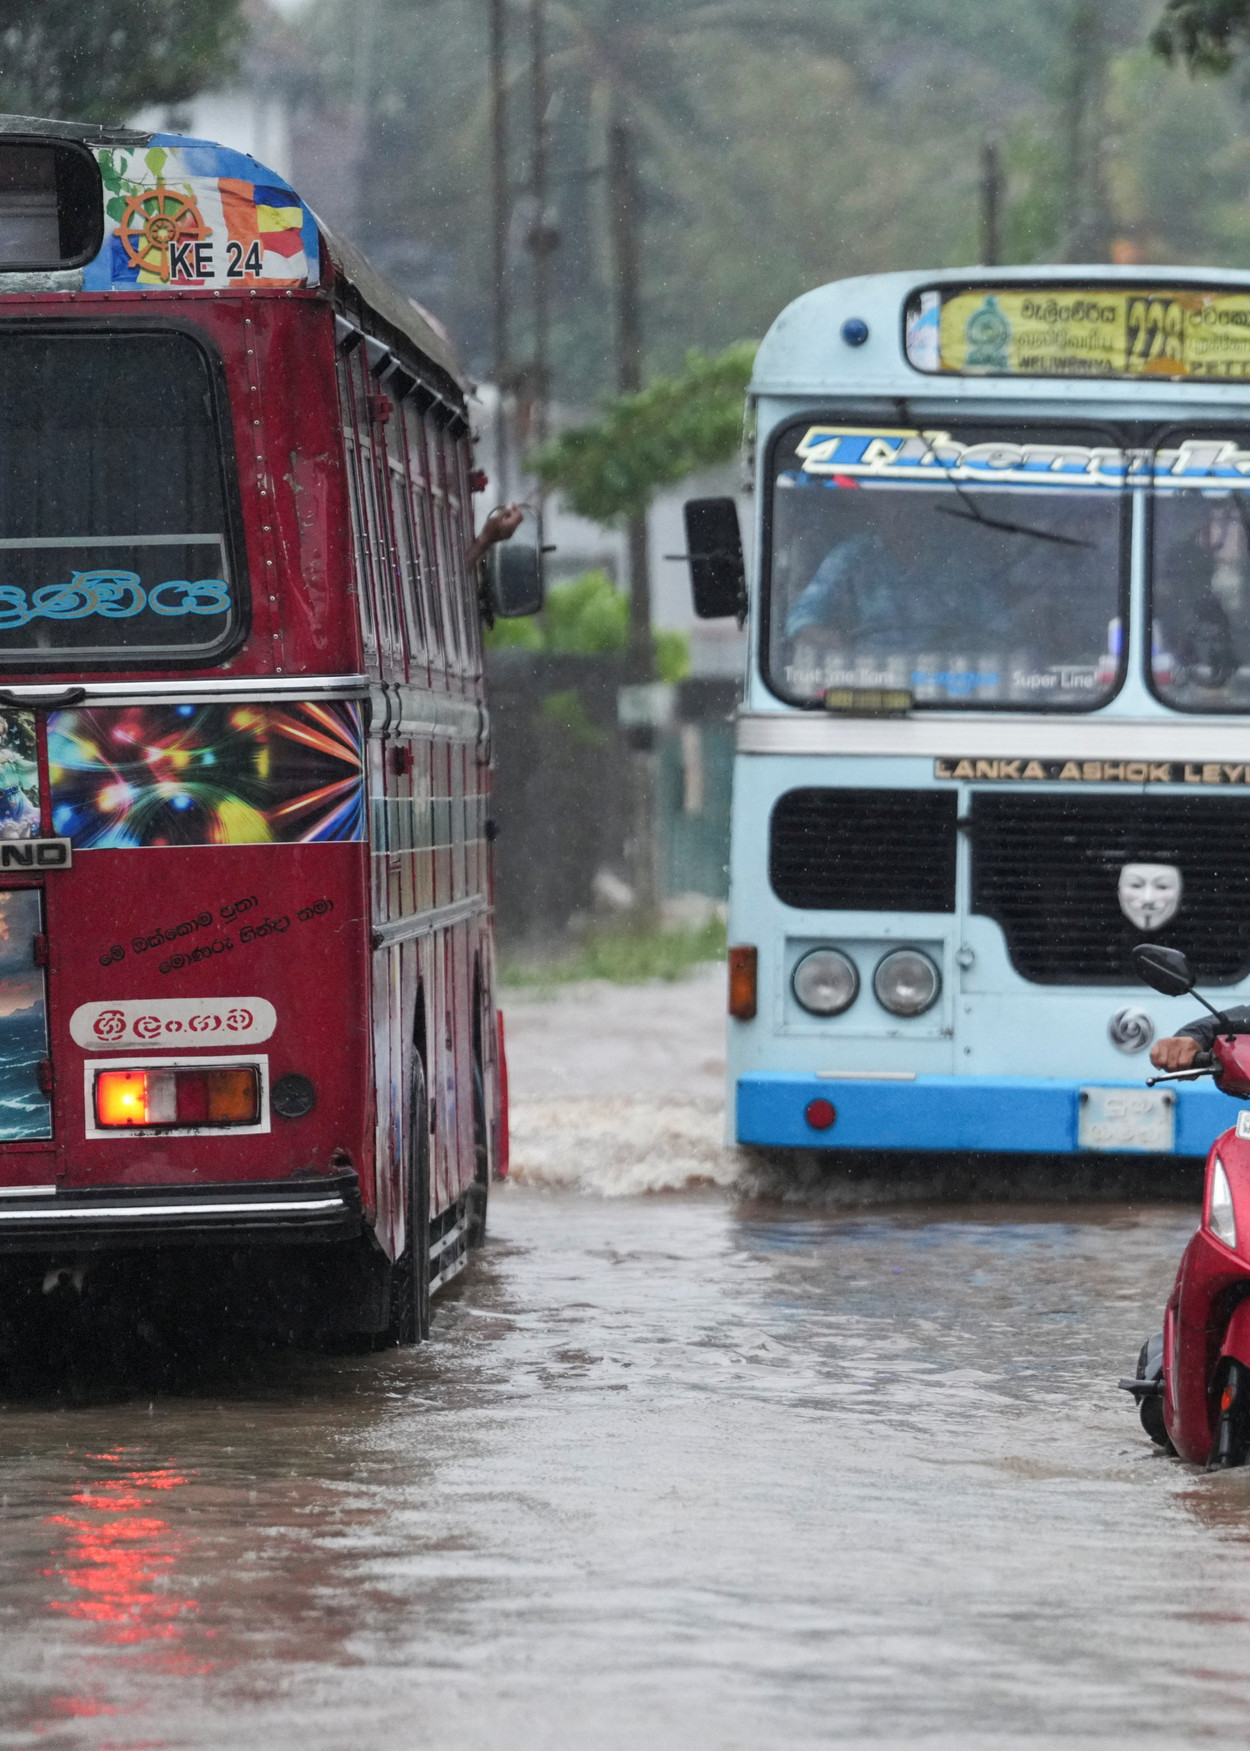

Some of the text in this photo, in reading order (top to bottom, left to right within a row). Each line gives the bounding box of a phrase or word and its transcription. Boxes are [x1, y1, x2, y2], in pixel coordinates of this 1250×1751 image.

[170, 241, 262, 278] KE 24
[1012, 670, 1056, 690] Super
[935, 757, 1045, 780] LANKA
[1058, 760, 1171, 783] ASHOK
